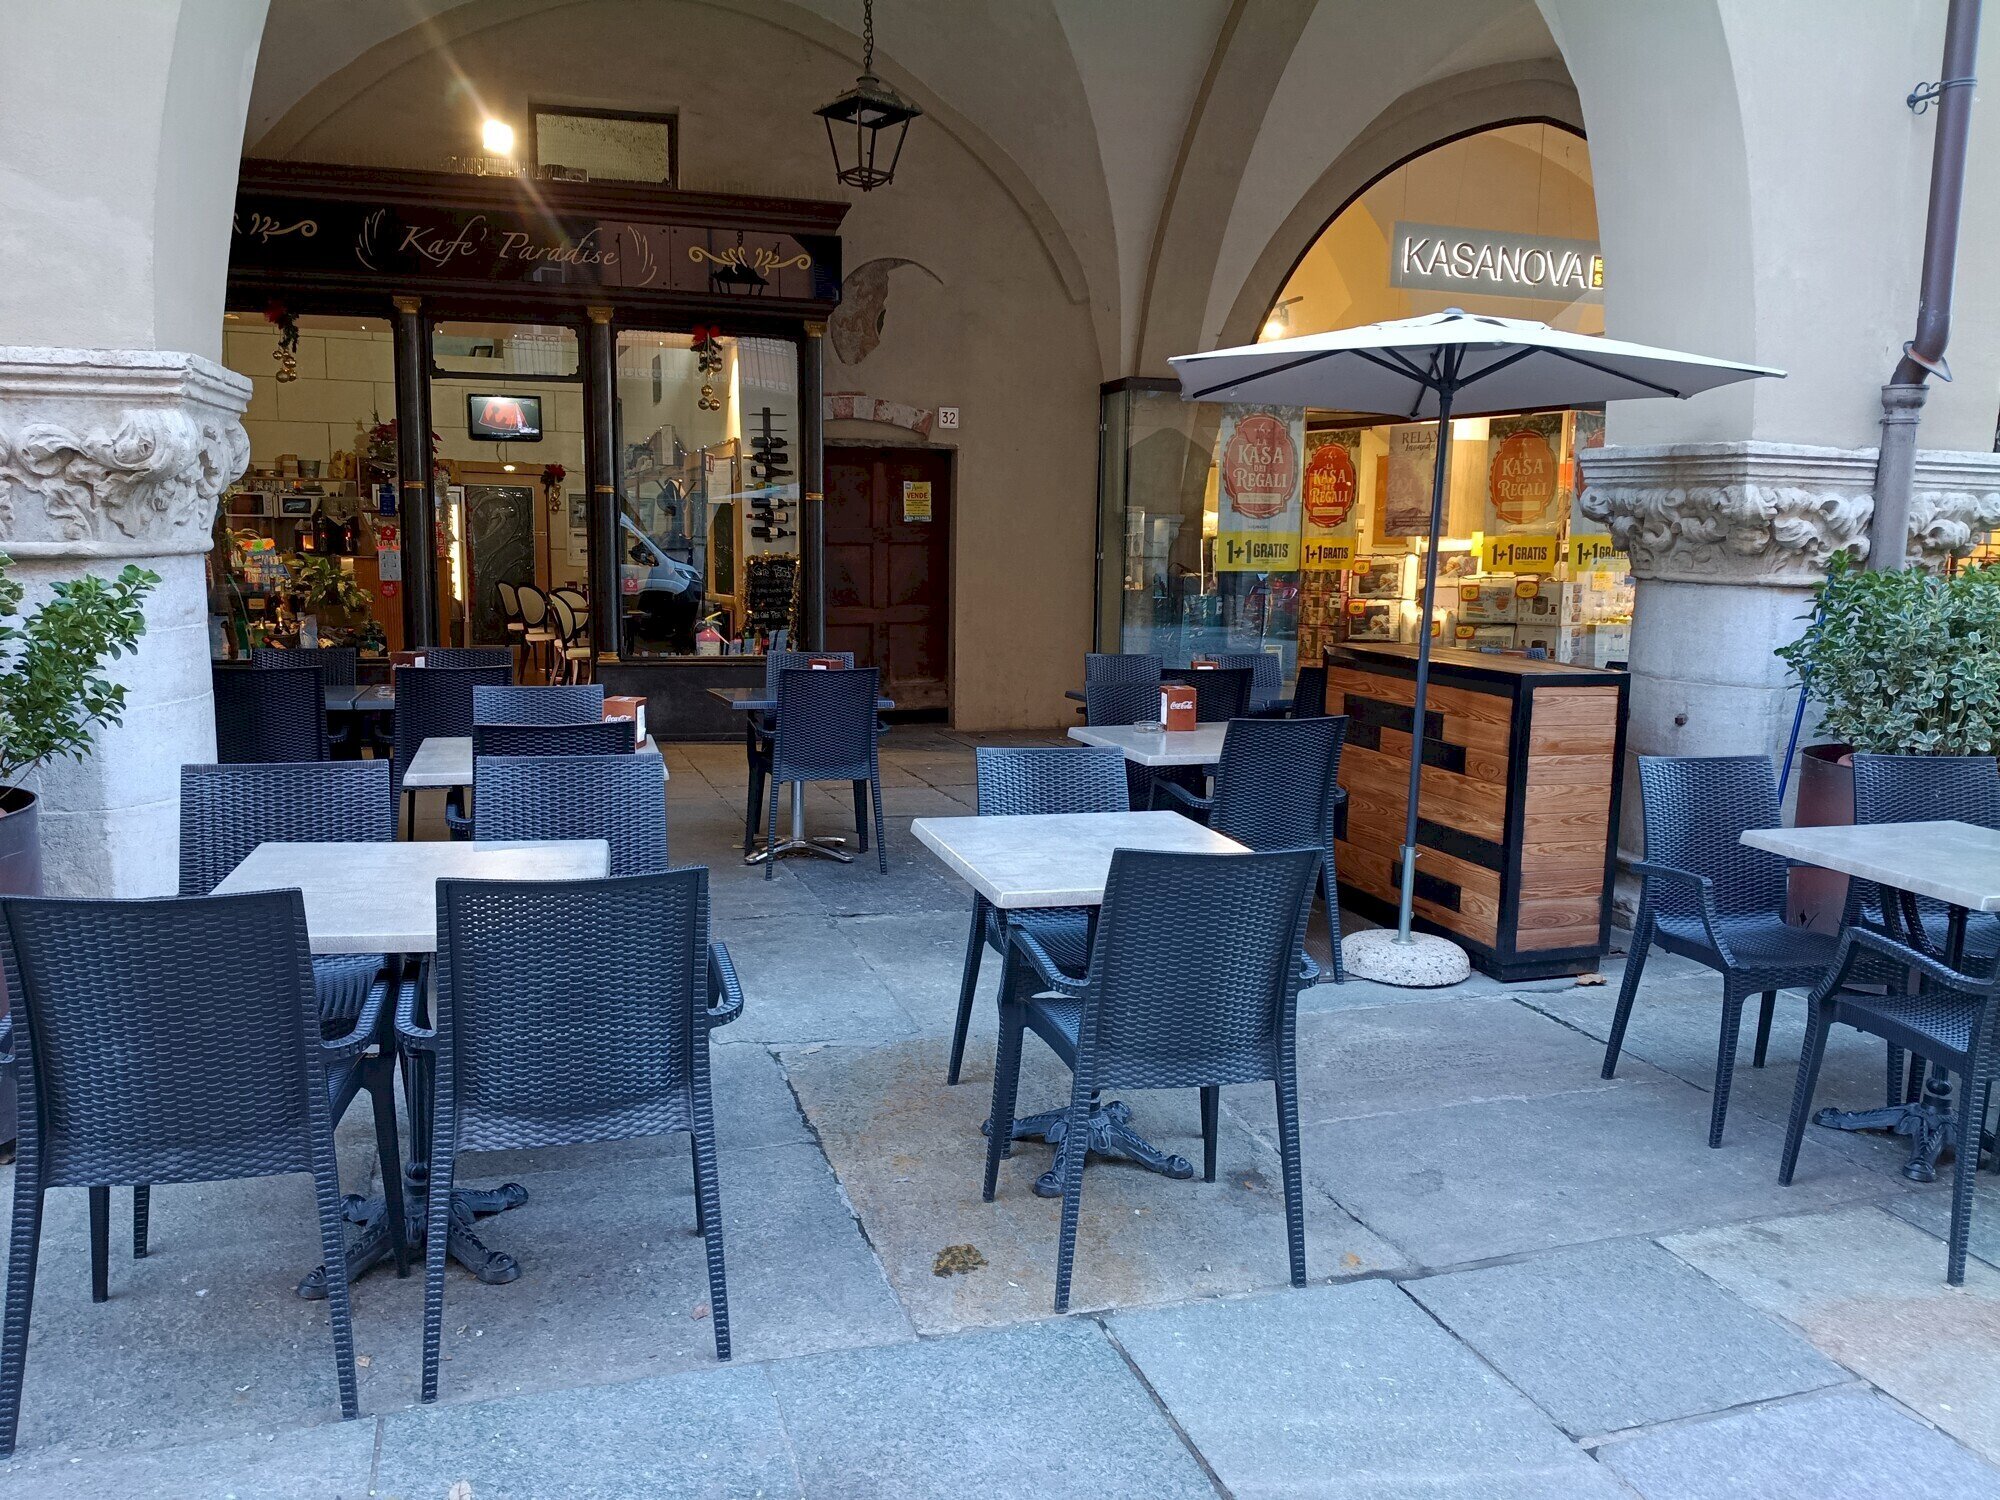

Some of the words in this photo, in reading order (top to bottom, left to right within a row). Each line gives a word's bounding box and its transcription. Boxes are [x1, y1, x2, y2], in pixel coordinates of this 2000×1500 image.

[499, 227, 620, 265] Paradise
[1403, 236, 1587, 289] KASANOVA
[941, 411, 956, 425] 32
[1237, 443, 1284, 465] KASA
[1518, 451, 1529, 459] LA
[1253, 465, 1267, 473] DEI
[1313, 468, 1347, 486] KASA
[1502, 457, 1544, 477] KASA
[1232, 468, 1287, 491] REGALI
[1309, 487, 1349, 506] REGALI
[1227, 539, 1252, 564] 1+1
[1253, 543, 1289, 558] GRATIS
[1305, 544, 1323, 564] 1+1
[1323, 546, 1349, 559] GRATIS
[1492, 543, 1514, 566] 1+1
[1515, 546, 1548, 561] GRATIS
[1577, 542, 1599, 565] 1+1
